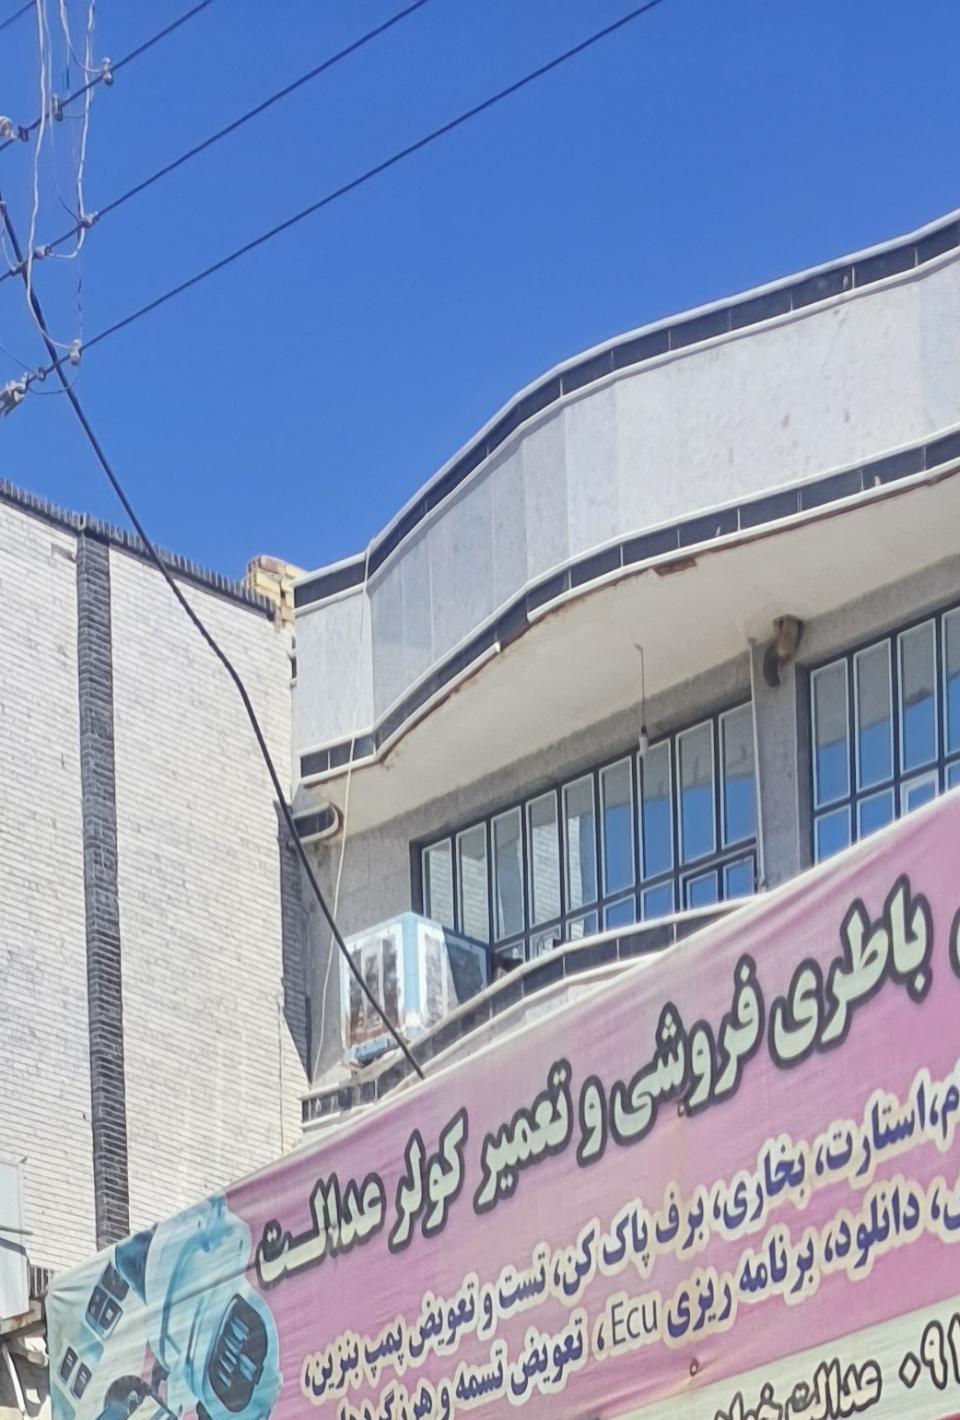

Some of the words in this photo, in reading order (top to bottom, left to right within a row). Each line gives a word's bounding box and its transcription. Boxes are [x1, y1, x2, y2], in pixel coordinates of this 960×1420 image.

[770, 873, 933, 1068] باطری
[609, 953, 764, 1146] فروشی
[474, 1059, 573, 1214] تعمیر
[576, 1075, 606, 1167] و
[388, 1107, 468, 1254] کولر
[255, 1171, 387, 1290] عدالت
[602, 1208, 649, 1268] پاک
[655, 1190, 705, 1250] برف
[482, 1291, 493, 1332] و
[498, 1251, 546, 1309] تست
[666, 1276, 733, 1338] ریزی
[364, 1322, 403, 1379] پمپ
[408, 1281, 475, 1358] تعویض
[510, 1317, 584, 1396] تعویض
[455, 1347, 504, 1400] تسمه
